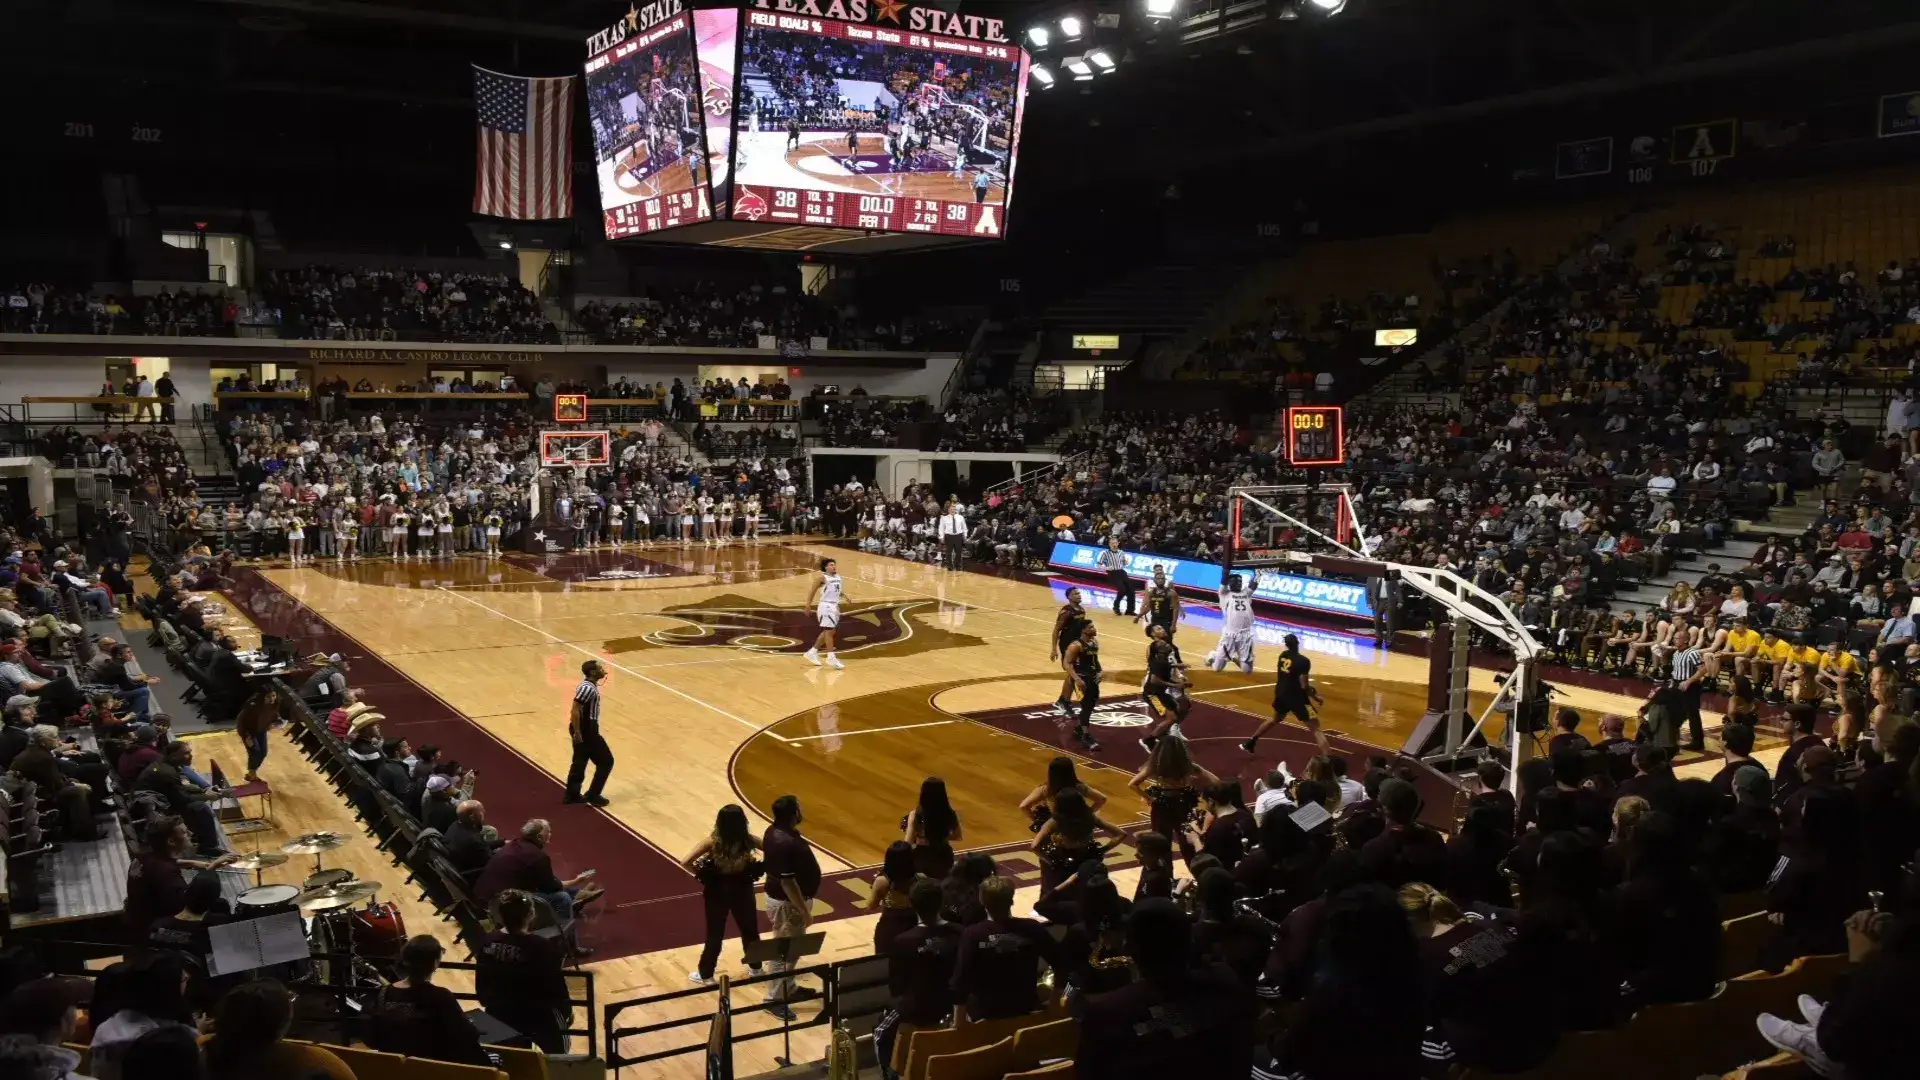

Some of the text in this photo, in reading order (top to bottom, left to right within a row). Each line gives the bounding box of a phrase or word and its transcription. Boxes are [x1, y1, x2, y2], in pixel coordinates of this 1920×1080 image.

[586, 19, 626, 59] TEXAS
[640, 0, 684, 31] STATE
[751, 13, 776, 26] FIELD
[780, 16, 809, 31] GOALS
[909, 6, 1005, 43] STATE
[64, 122, 94, 137] 201
[131, 126, 163, 142] 202
[1692, 159, 1716, 176] 107
[775, 190, 797, 208] 38
[947, 204, 967, 220] 38
[859, 214, 889, 229] PER 1
[999, 279, 1021, 292] 105
[309, 349, 376, 360] RICHARD
[396, 351, 449, 361] CASTRO
[452, 351, 504, 361] LEGACY
[508, 352, 543, 363] CLUB
[1258, 575, 1303, 595] GOOD
[1303, 581, 1364, 604] SPORT
[1235, 600, 1247, 612] 25
